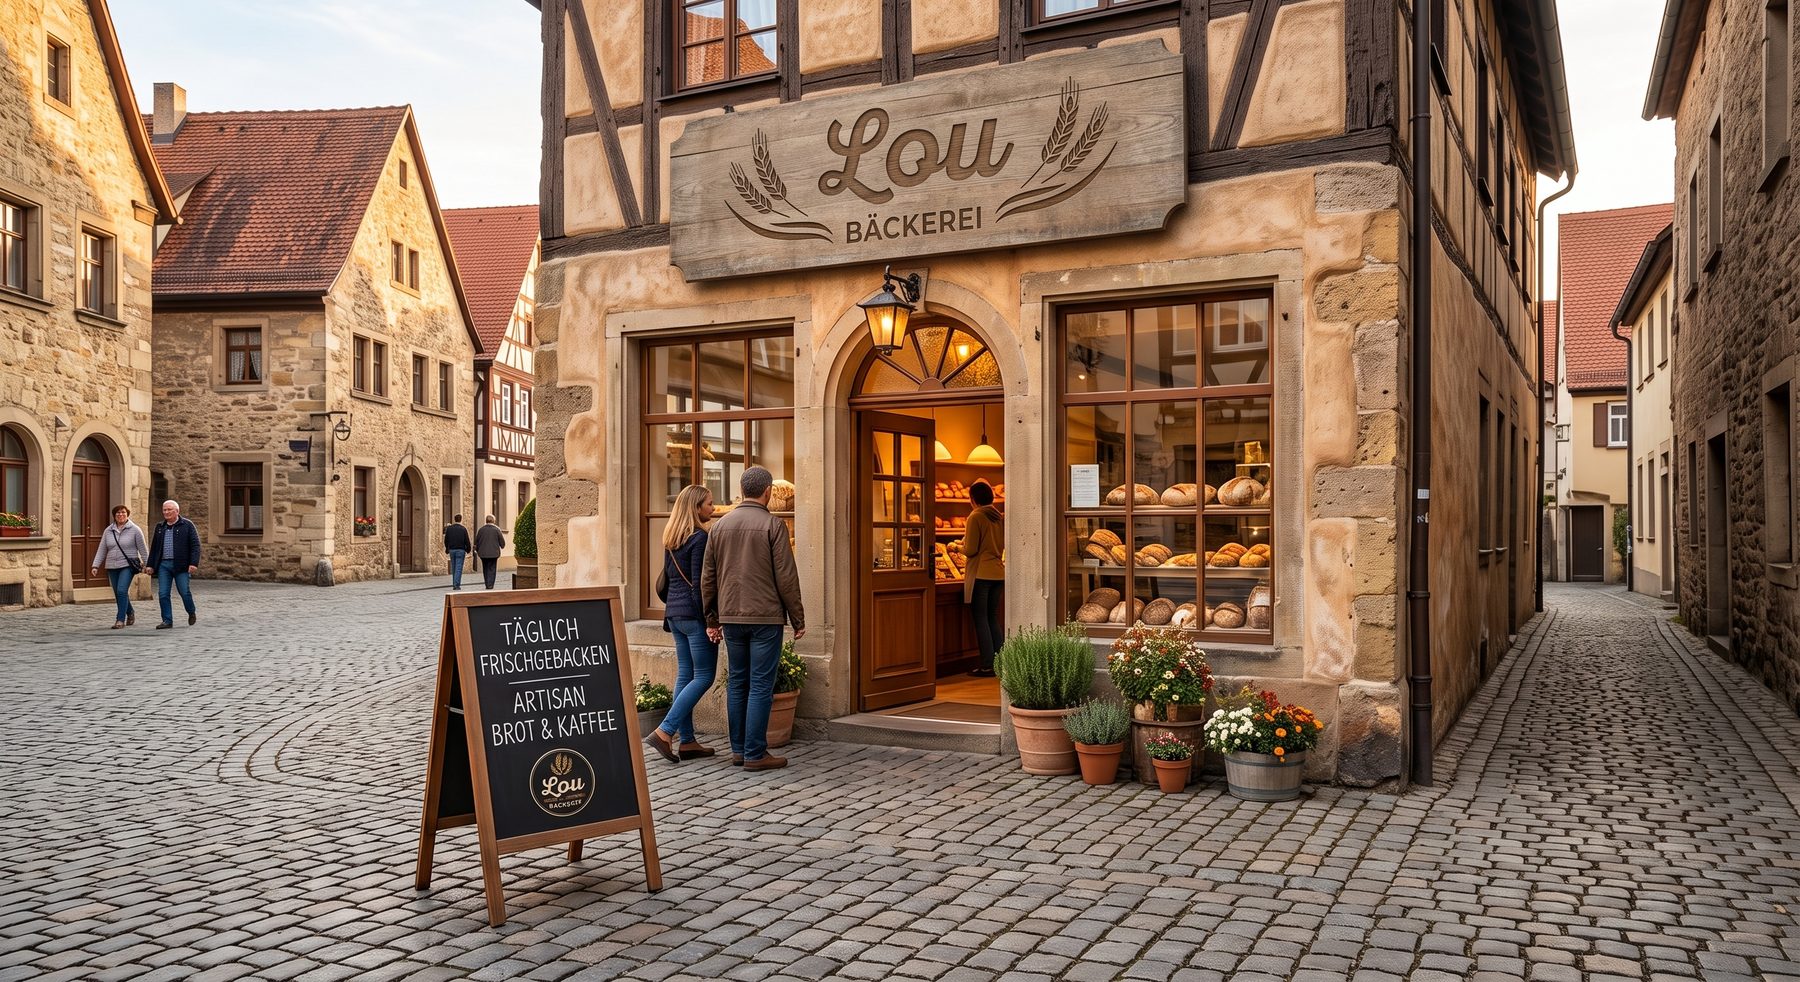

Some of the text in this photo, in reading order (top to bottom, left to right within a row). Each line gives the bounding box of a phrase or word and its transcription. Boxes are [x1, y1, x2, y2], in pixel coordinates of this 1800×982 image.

[817, 107, 1015, 205] Lou
[846, 205, 983, 244] BÄCKEREI
[500, 616, 580, 645] TÄGLICH
[480, 644, 611, 677] FRISCHGEBACKEN
[513, 685, 586, 714] ARTISAN
[492, 709, 618, 747] BROT & KAFFEE
[541, 776, 586, 798] Lou
